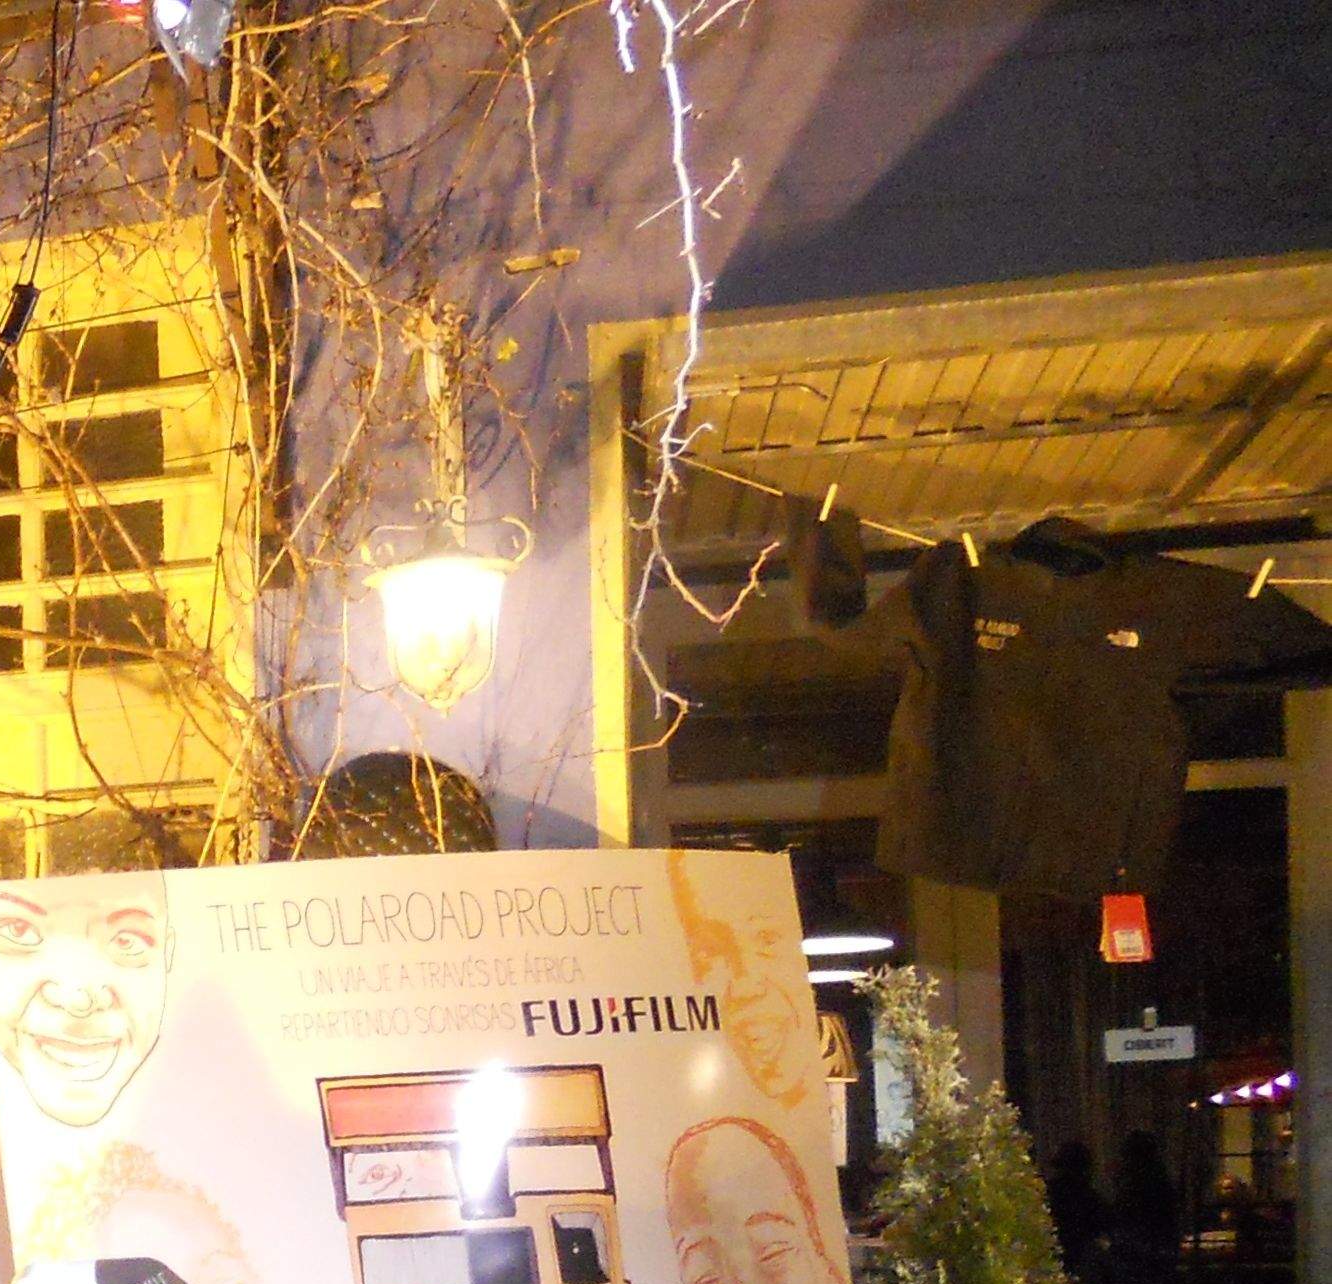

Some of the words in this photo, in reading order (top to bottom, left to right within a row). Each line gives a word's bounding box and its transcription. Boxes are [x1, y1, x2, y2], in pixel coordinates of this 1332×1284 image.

[206, 901, 272, 954] THE
[282, 891, 484, 950] POLAROAD
[496, 885, 644, 940] PROJECT
[298, 968, 335, 997] UN
[337, 963, 394, 995] VIAJE
[494, 958, 518, 988] DE
[279, 1007, 407, 1042] REPARTIENDO
[411, 1002, 517, 1037] SONRISAS
[520, 994, 722, 1039] FUJIFILM
